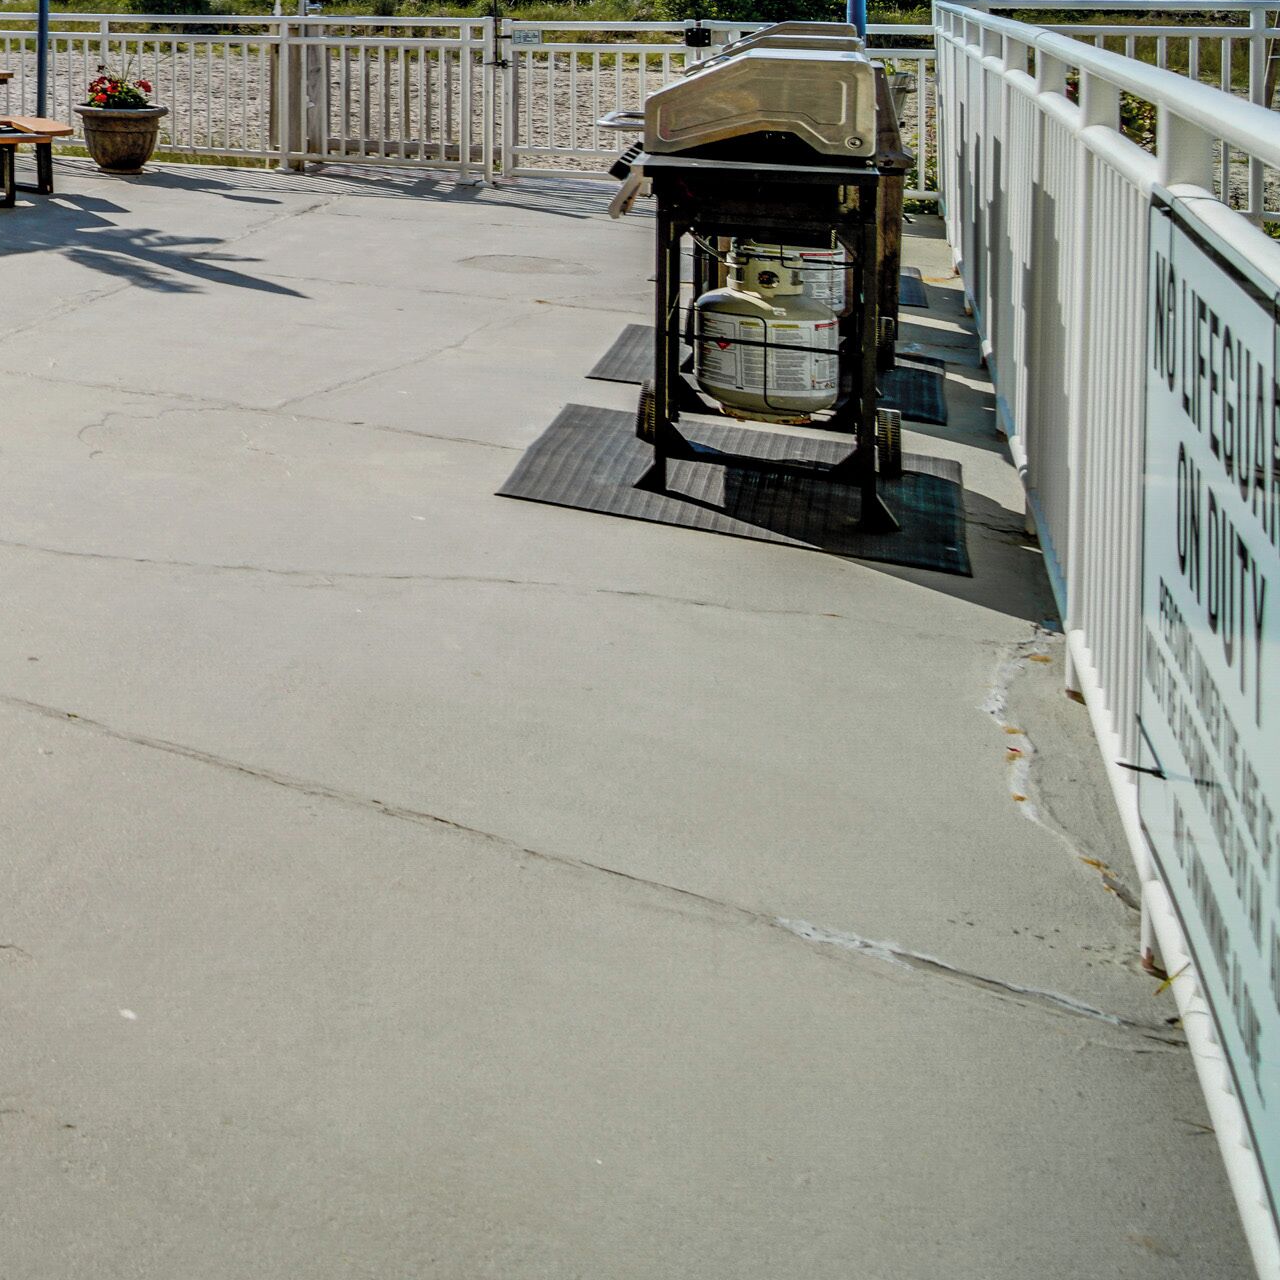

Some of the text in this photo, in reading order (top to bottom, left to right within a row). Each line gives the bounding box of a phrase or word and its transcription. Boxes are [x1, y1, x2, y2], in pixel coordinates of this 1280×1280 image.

[1154, 251, 1176, 393] NO
[1177, 441, 1267, 729] ON DUTY
